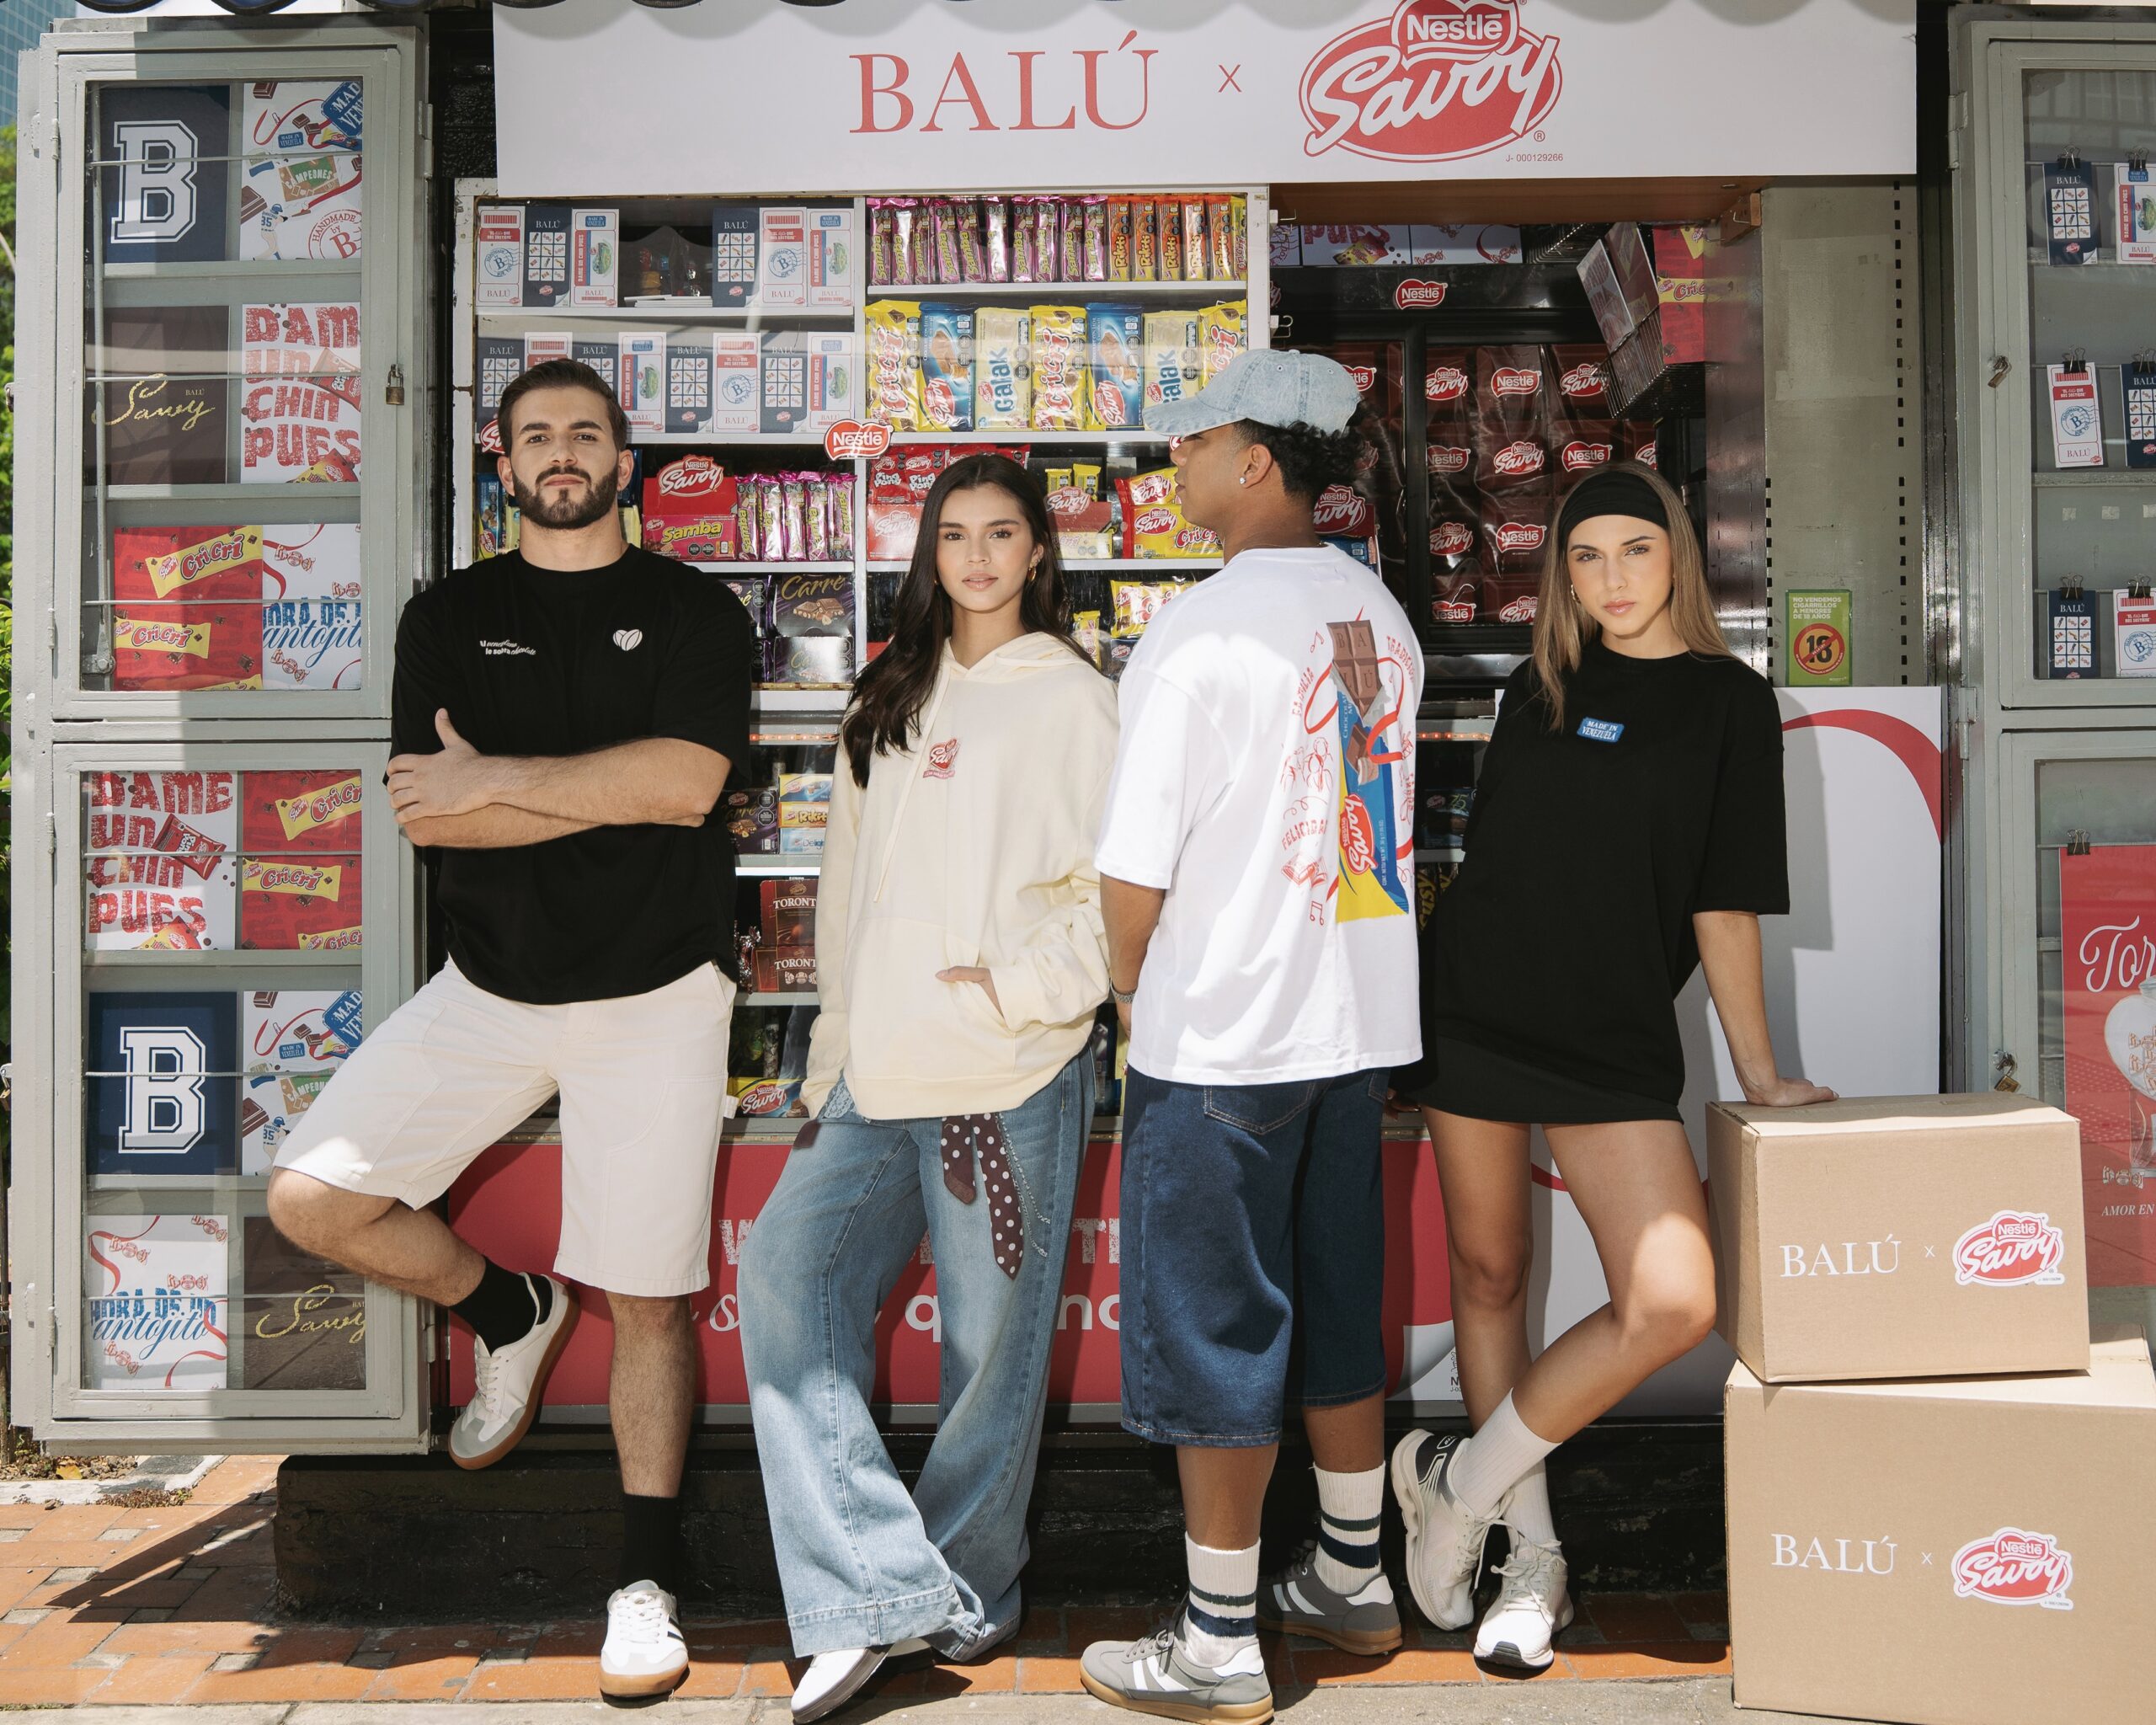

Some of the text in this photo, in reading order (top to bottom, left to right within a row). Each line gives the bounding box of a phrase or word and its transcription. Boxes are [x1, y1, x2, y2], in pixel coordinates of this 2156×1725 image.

[848, 30, 1159, 133] BALÚ
[1305, 35, 1561, 157] Savoy
[110, 120, 198, 244] B
[285, 169, 332, 190] CAMPEONES
[2057, 175, 2081, 184] BALÚ
[312, 212, 357, 243] HANDMADE
[330, 225, 340, 235] by
[536, 219, 560, 229] BALÚ
[724, 221, 748, 229] BALÚ
[1401, 287, 1439, 299] Nestlé
[1157, 350, 1182, 405] alak
[1497, 376, 1534, 387] Nestlé
[927, 379, 955, 423] Savoy
[1098, 381, 1126, 426] Savoy
[1495, 451, 1543, 473] Savoy
[1568, 449, 1604, 461] Nestlé
[660, 468, 723, 495] Savoy
[1046, 495, 1090, 513] Savoy
[1313, 498, 1363, 527] avoy
[662, 521, 723, 544] Samba
[875, 517, 916, 536] Savoy
[1135, 514, 1178, 534] Savoy
[782, 575, 846, 600] Carré
[2060, 603, 2084, 612] BALÚ
[1806, 635, 1833, 663] 18
[1582, 726, 1616, 740] VENEZUELA
[1587, 720, 1608, 730] MADE
[90, 772, 233, 814] DAME
[1344, 797, 1379, 871] Savoy
[119, 1027, 205, 1154] B
[742, 1088, 786, 1114] Savoy
[2102, 1204, 2155, 1216] AMOR EN
[1780, 1233, 1902, 1278] BALÚ
[1960, 1231, 2058, 1281] Savoy
[1771, 1533, 1897, 1574] BALÚ
[1958, 1551, 2067, 1594] Savoy
